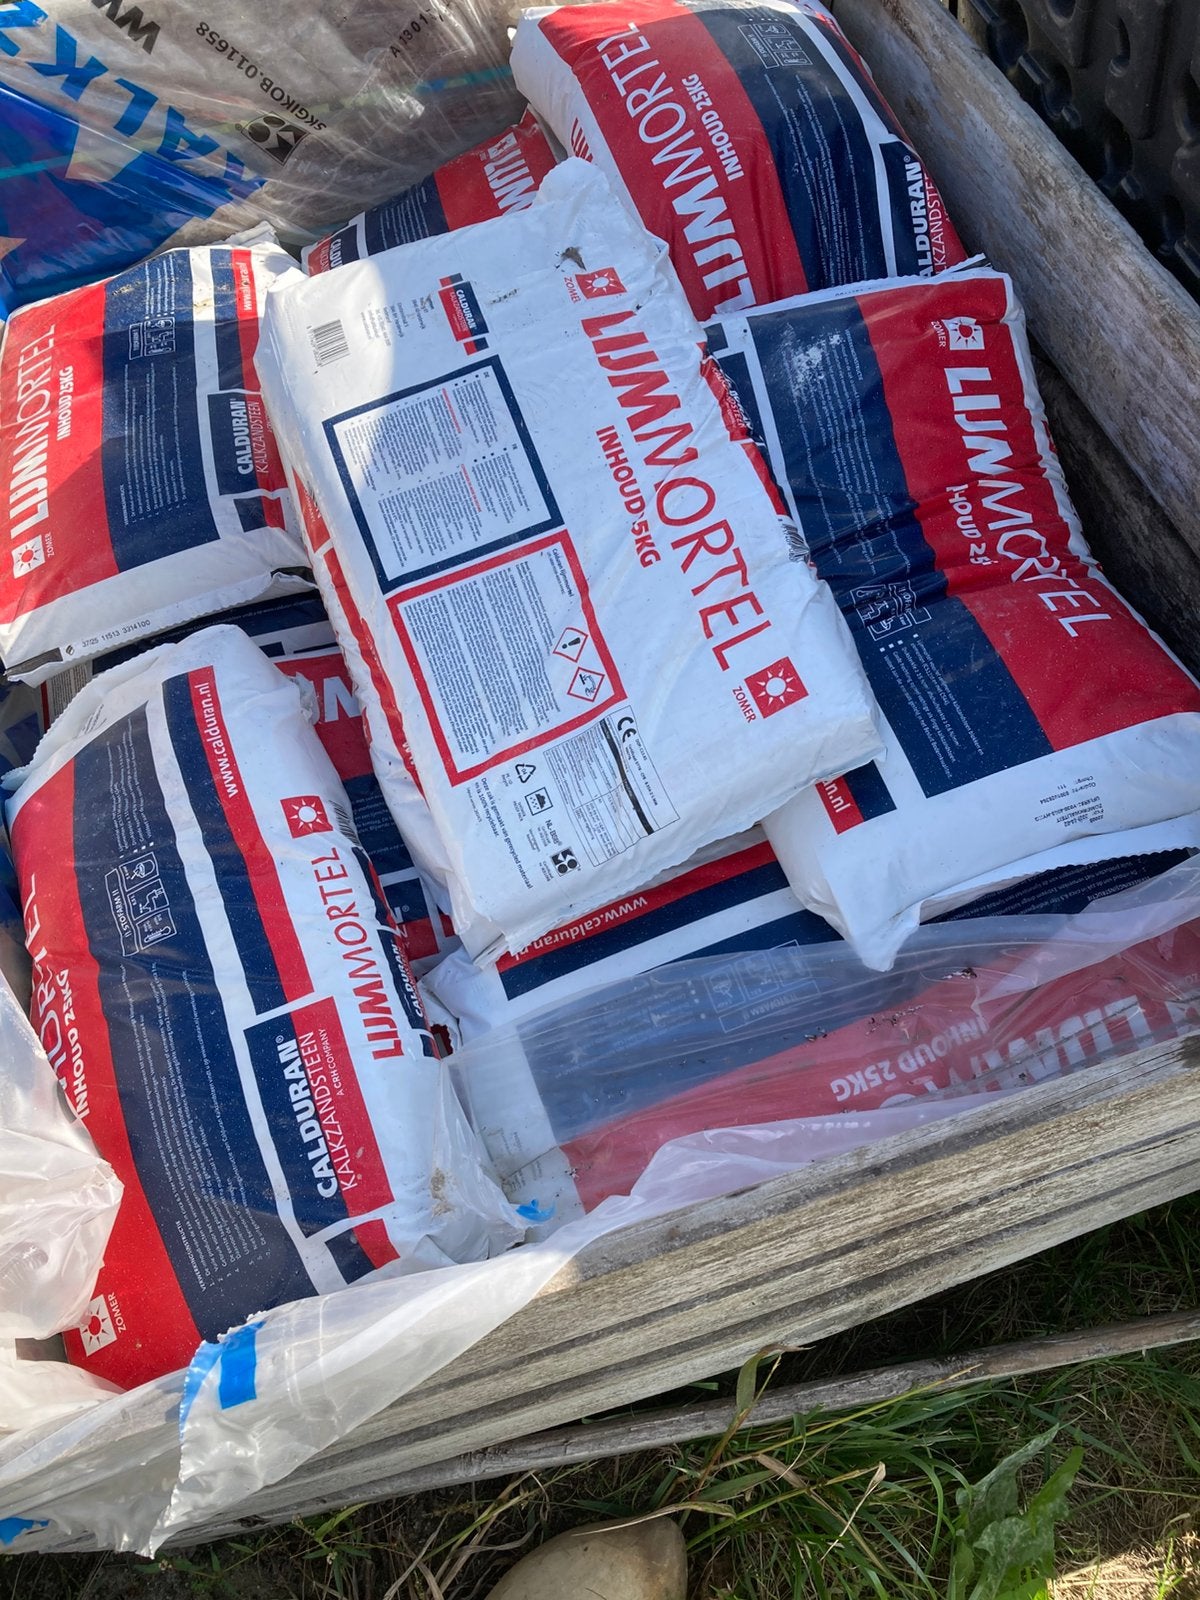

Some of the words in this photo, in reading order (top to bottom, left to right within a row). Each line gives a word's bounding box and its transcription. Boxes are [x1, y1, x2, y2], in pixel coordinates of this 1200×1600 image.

[196, 21, 327, 131] SKGIKOB.011658
[682, 73, 715, 112] 25KG
[597, 22, 756, 315] LIJMMORTEL
[702, 112, 744, 182] INHOUD
[455, 289, 479, 330] CALDURAN
[930, 321, 947, 347] ZOMER
[59, 366, 73, 396] 25KG
[9, 323, 56, 539] LIJMMORTEL
[56, 396, 73, 440] INHOUD
[249, 402, 269, 474] KALKZANDSTEEN
[581, 310, 772, 671] LIJMMORTEL
[596, 425, 646, 514] INHOUD
[630, 514, 661, 569] 5KG
[618, 716, 637, 743] CE
[732, 686, 757, 723] ZOMER
[201, 682, 240, 798] www.calduran.nl
[480, 776, 490, 791] Deze
[485, 789, 494, 800] zak
[490, 803, 505, 828] gemaakt
[504, 836, 521, 864] gerecycled
[516, 863, 533, 889] materiaal
[115, 898, 130, 928] STOFARM
[311, 847, 404, 1059] LIJMMORTEL
[391, 941, 424, 1018] CALDURAN
[55, 968, 77, 1027] 25KG
[67, 1027, 91, 1120] INHOUD
[898, 1014, 991, 1075] INHOUD
[301, 1031, 357, 1191] KALKZANDSTEEN
[829, 1058, 898, 1102] 25KG
[203, 1267, 211, 1276] De
[107, 1292, 127, 1333] ZOMER
